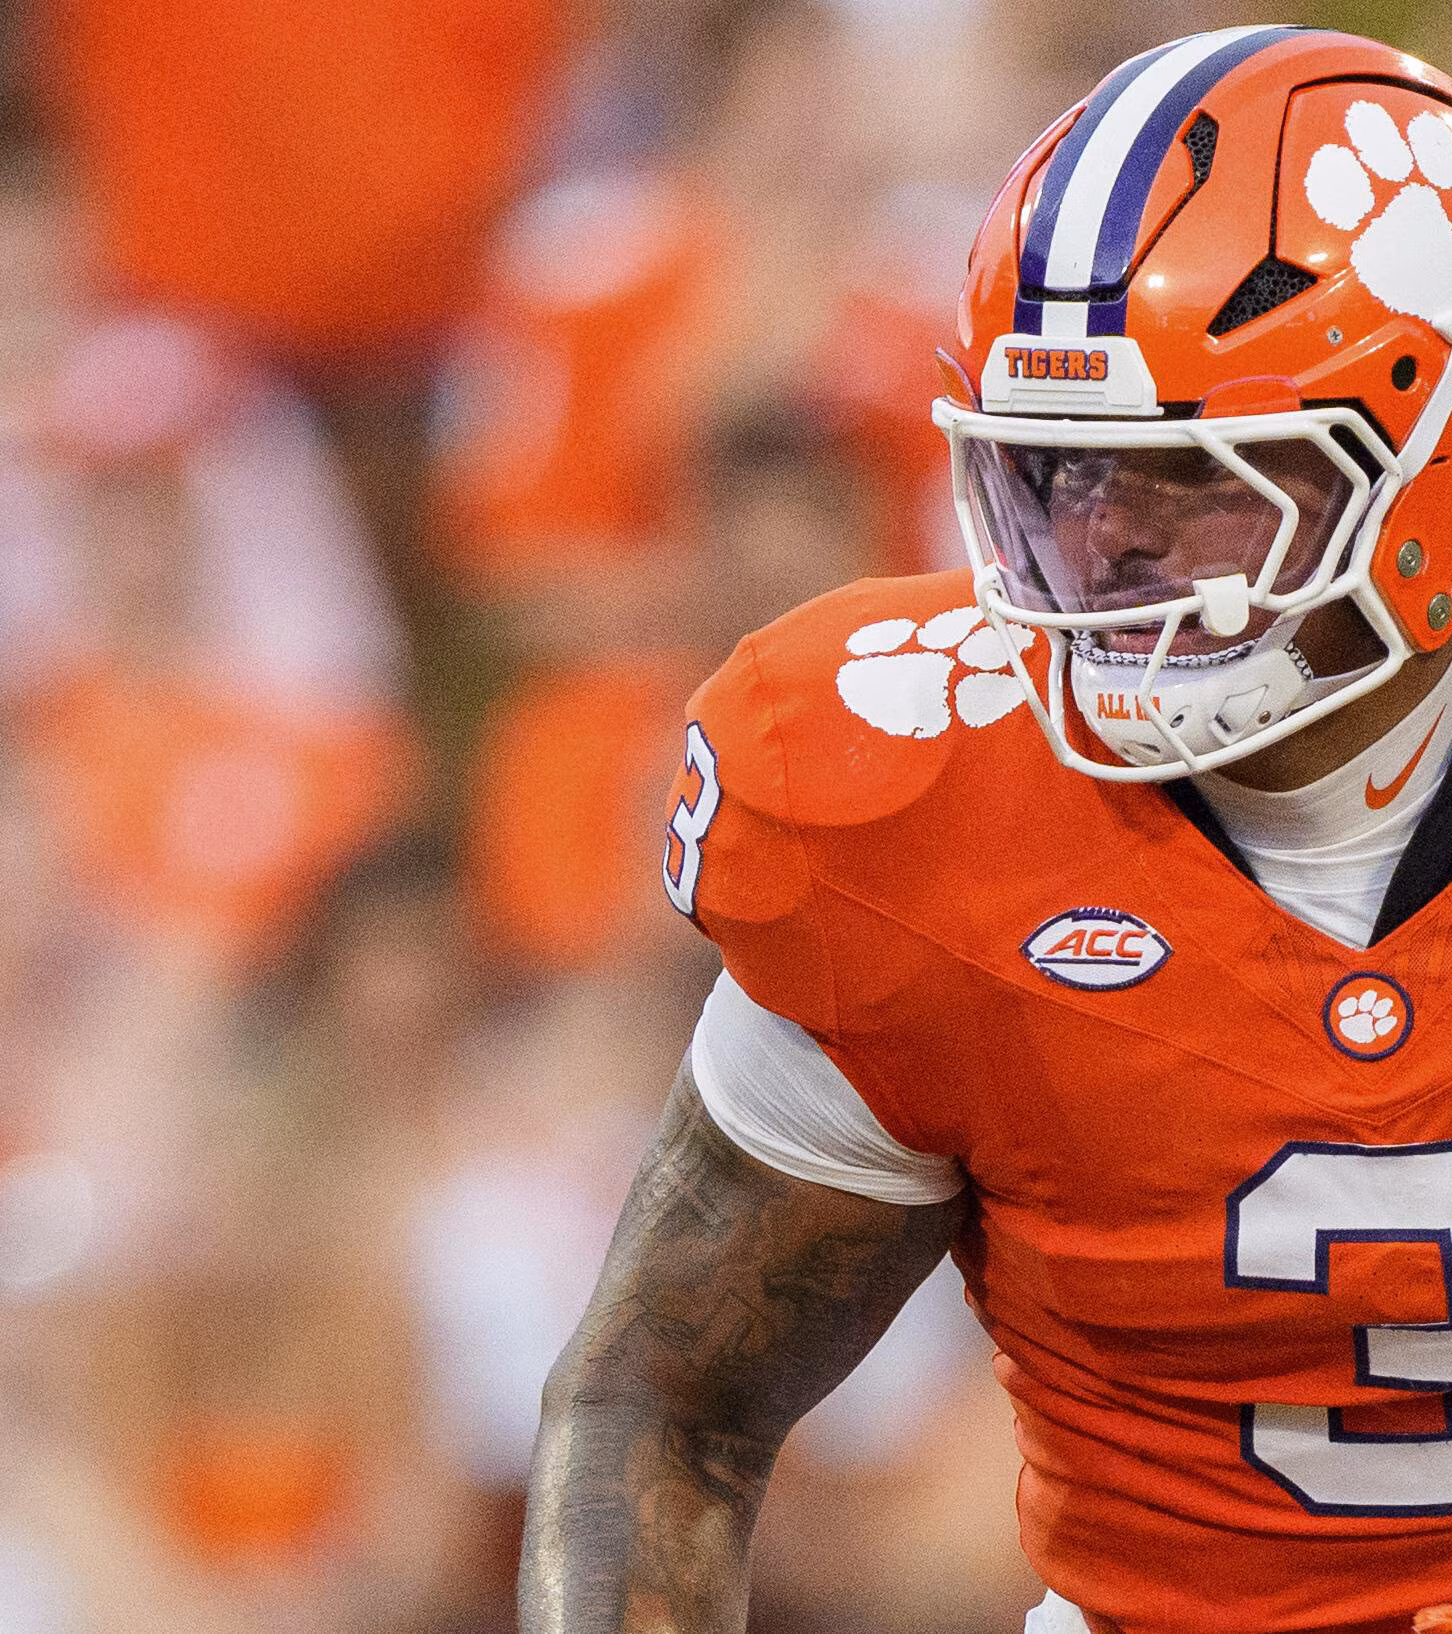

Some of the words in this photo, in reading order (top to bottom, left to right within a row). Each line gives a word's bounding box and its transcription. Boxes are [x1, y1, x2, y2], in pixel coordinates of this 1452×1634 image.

[1004, 347, 1109, 381] TIGERS
[1097, 693, 1131, 720] ALL
[662, 720, 723, 917] 3
[1044, 928, 1151, 958] ACC
